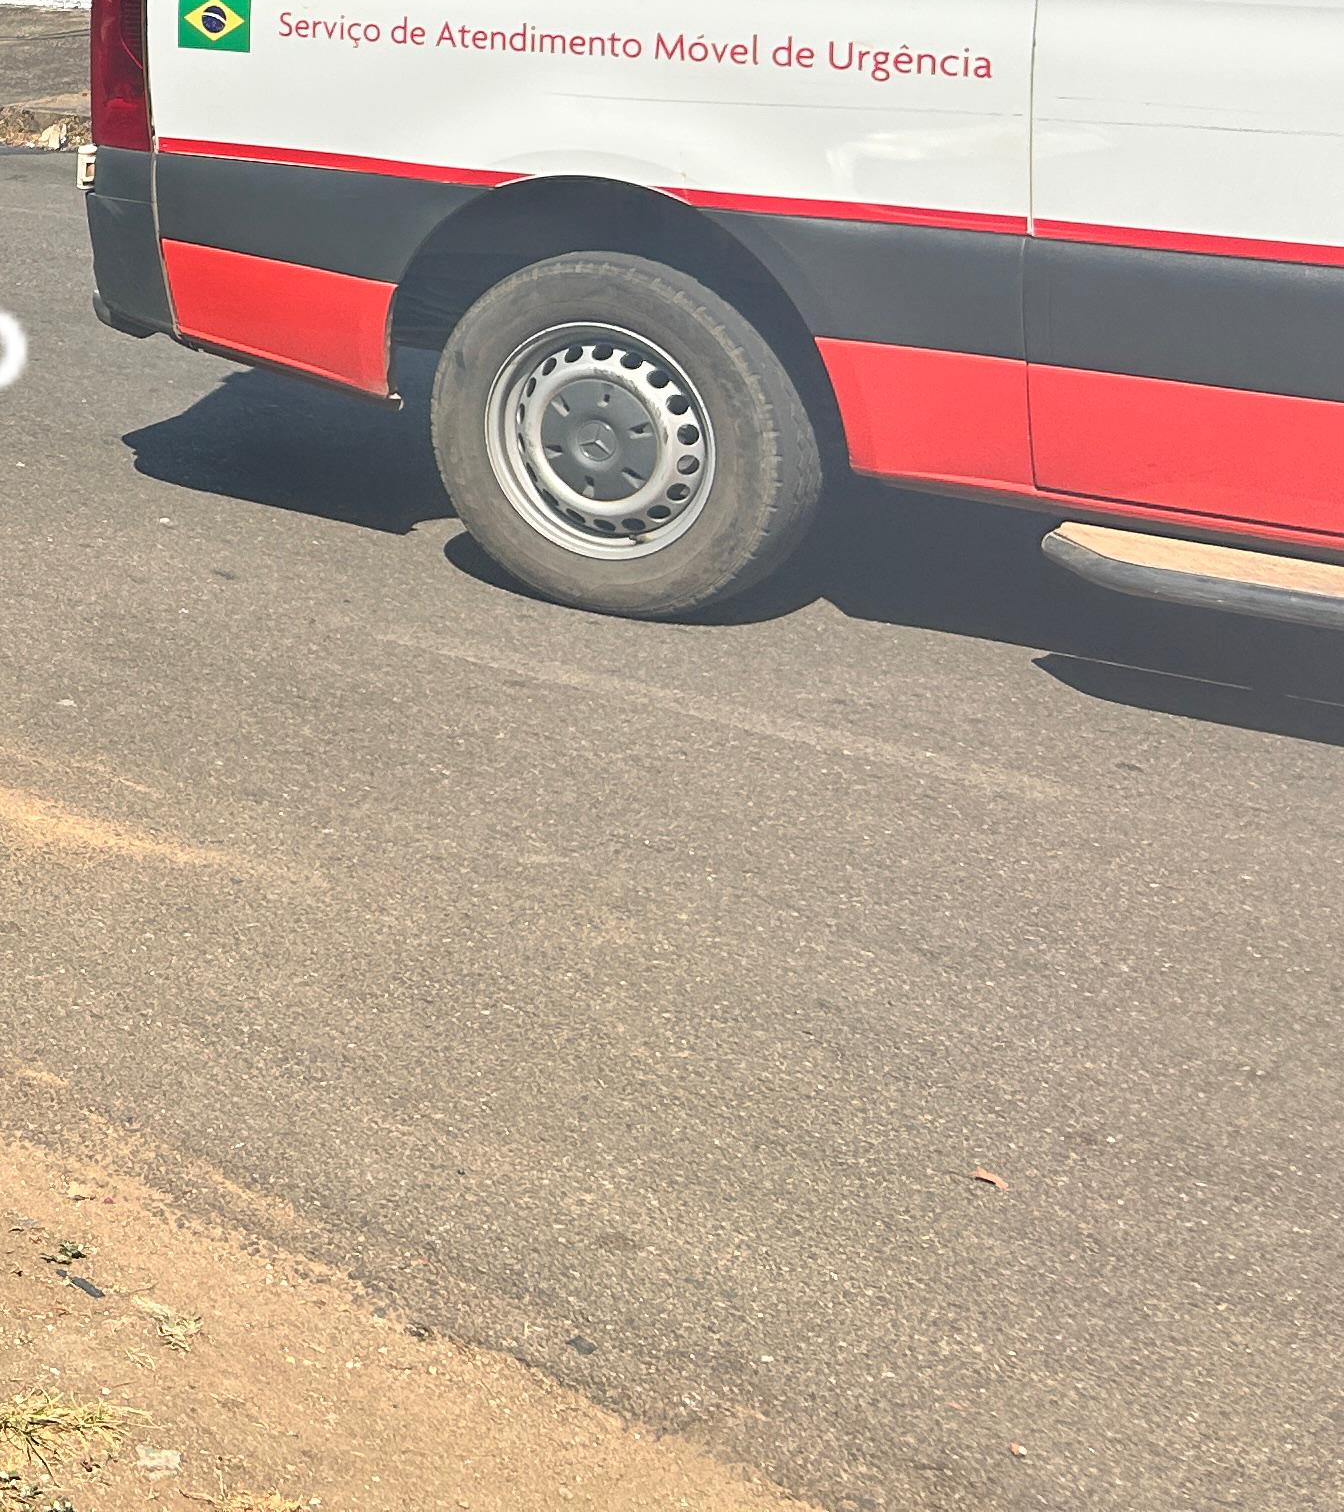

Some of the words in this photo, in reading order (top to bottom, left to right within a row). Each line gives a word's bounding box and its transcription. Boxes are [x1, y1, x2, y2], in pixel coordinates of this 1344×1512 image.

[278, 10, 382, 48] Serviço
[391, 19, 428, 46] de
[435, 23, 643, 59] Atendimento
[654, 33, 759, 66] Móvel
[770, 39, 817, 69] de
[827, 42, 994, 84] Urgência
